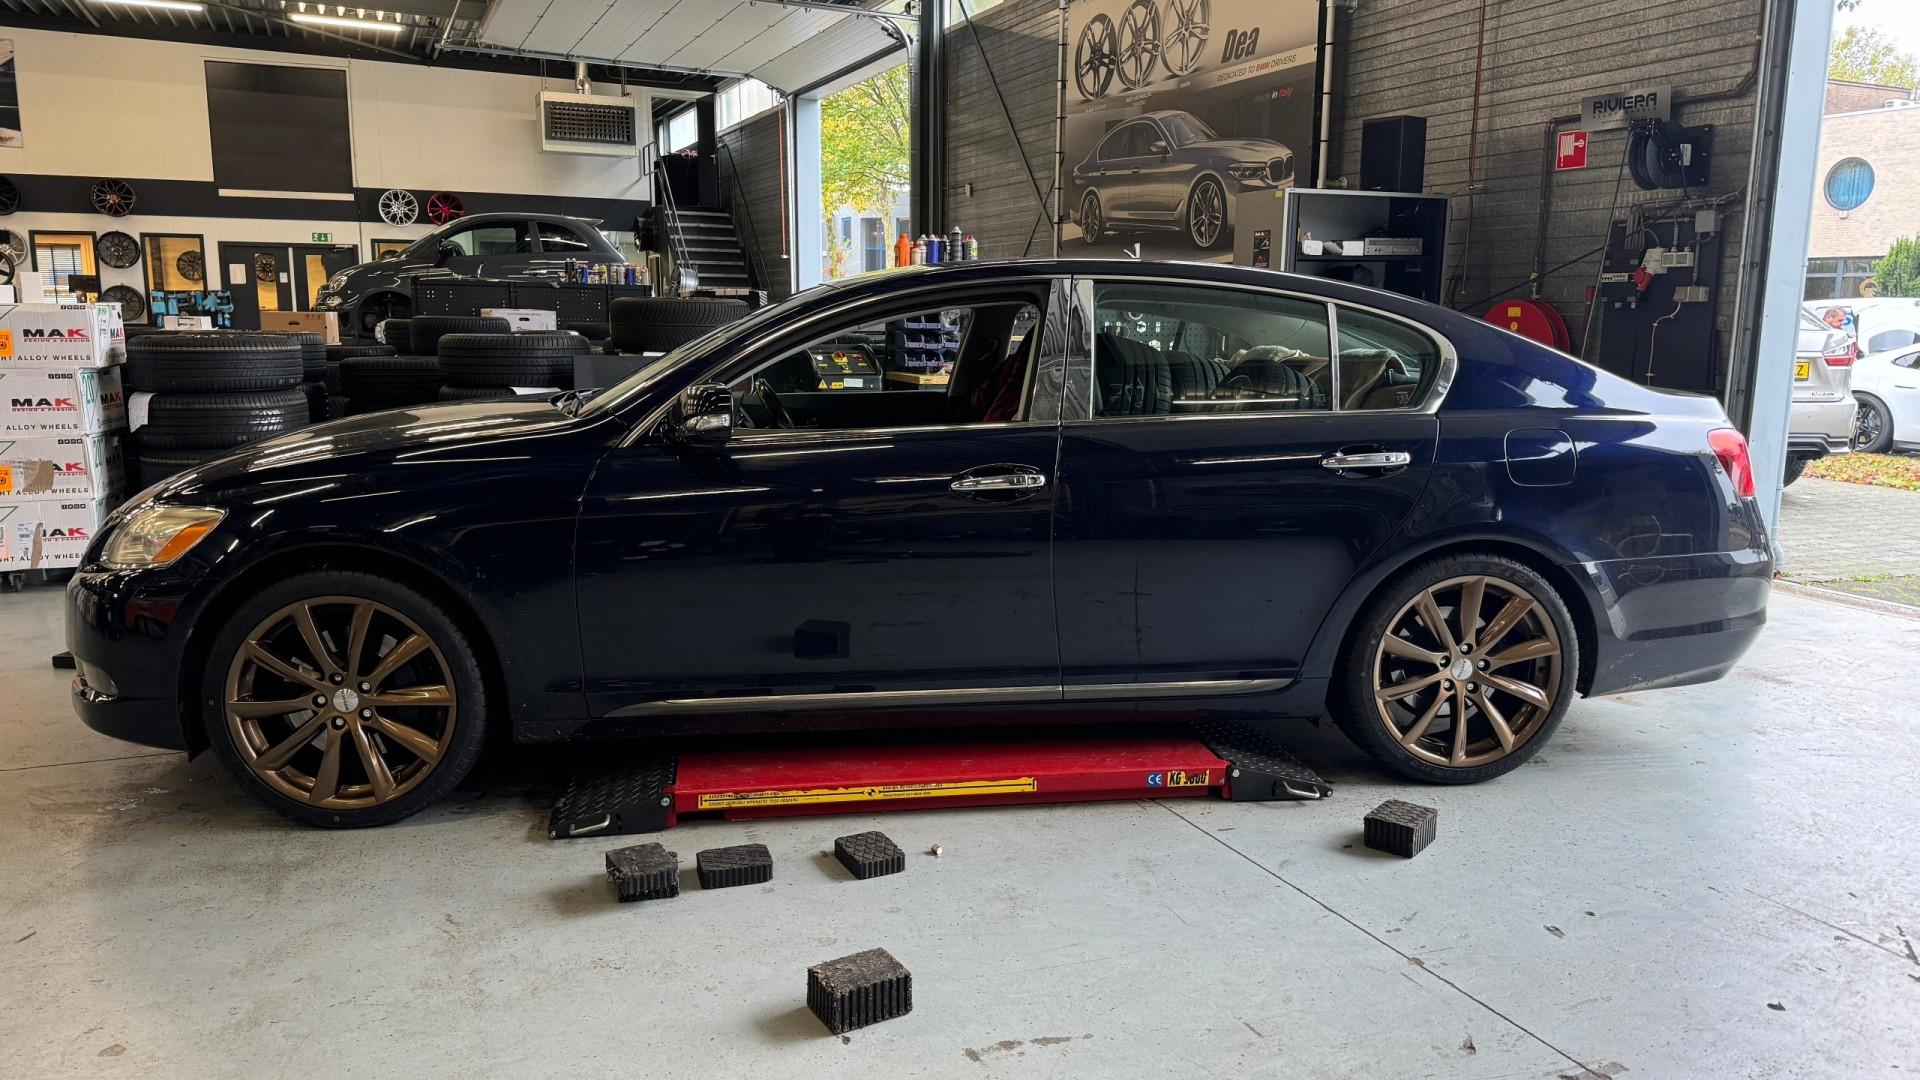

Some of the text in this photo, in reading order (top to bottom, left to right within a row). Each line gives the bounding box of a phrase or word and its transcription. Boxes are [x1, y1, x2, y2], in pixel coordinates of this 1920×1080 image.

[1221, 27, 1260, 64] Dea
[1217, 54, 1297, 82] DEDICATED TO BMW DRIVERS
[1592, 92, 1657, 114] RIVIERA
[23, 329, 89, 338] MAK
[11, 398, 77, 408] MAK
[52, 462, 87, 472] AK
[42, 527, 89, 538] AK
[1148, 774, 1162, 785] CE
[1169, 771, 1182, 786] KG
